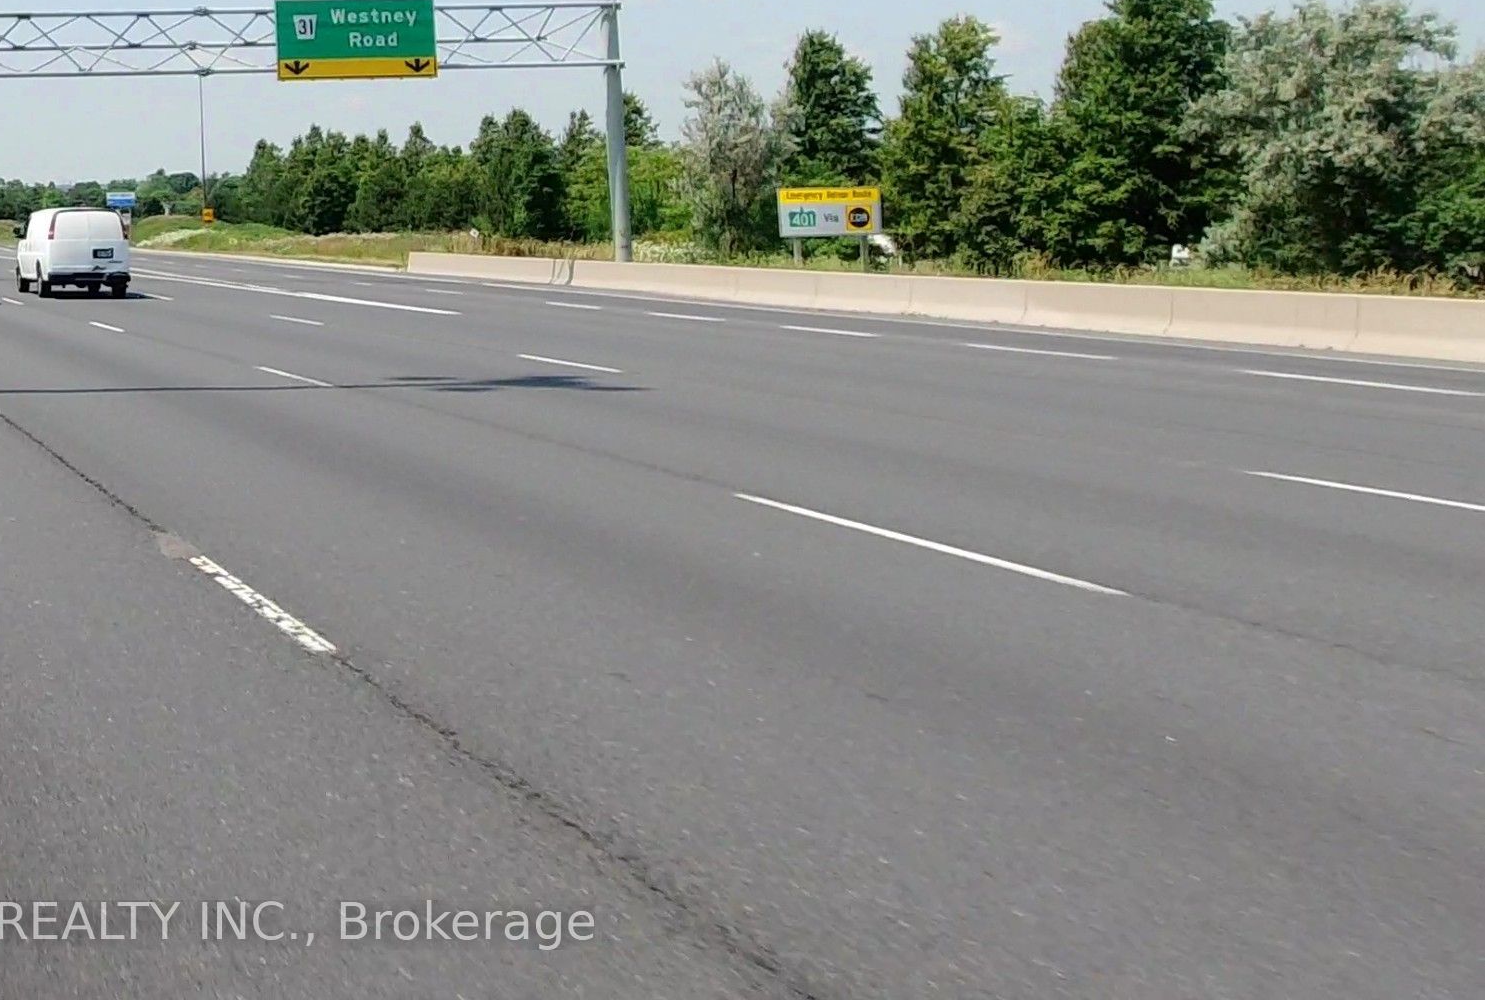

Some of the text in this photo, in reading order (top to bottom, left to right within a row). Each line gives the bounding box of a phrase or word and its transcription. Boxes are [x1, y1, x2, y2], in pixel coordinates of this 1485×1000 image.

[329, 7, 417, 27] Westney
[298, 18, 314, 36] 31
[348, 31, 398, 48] Road
[792, 213, 815, 226] 401
